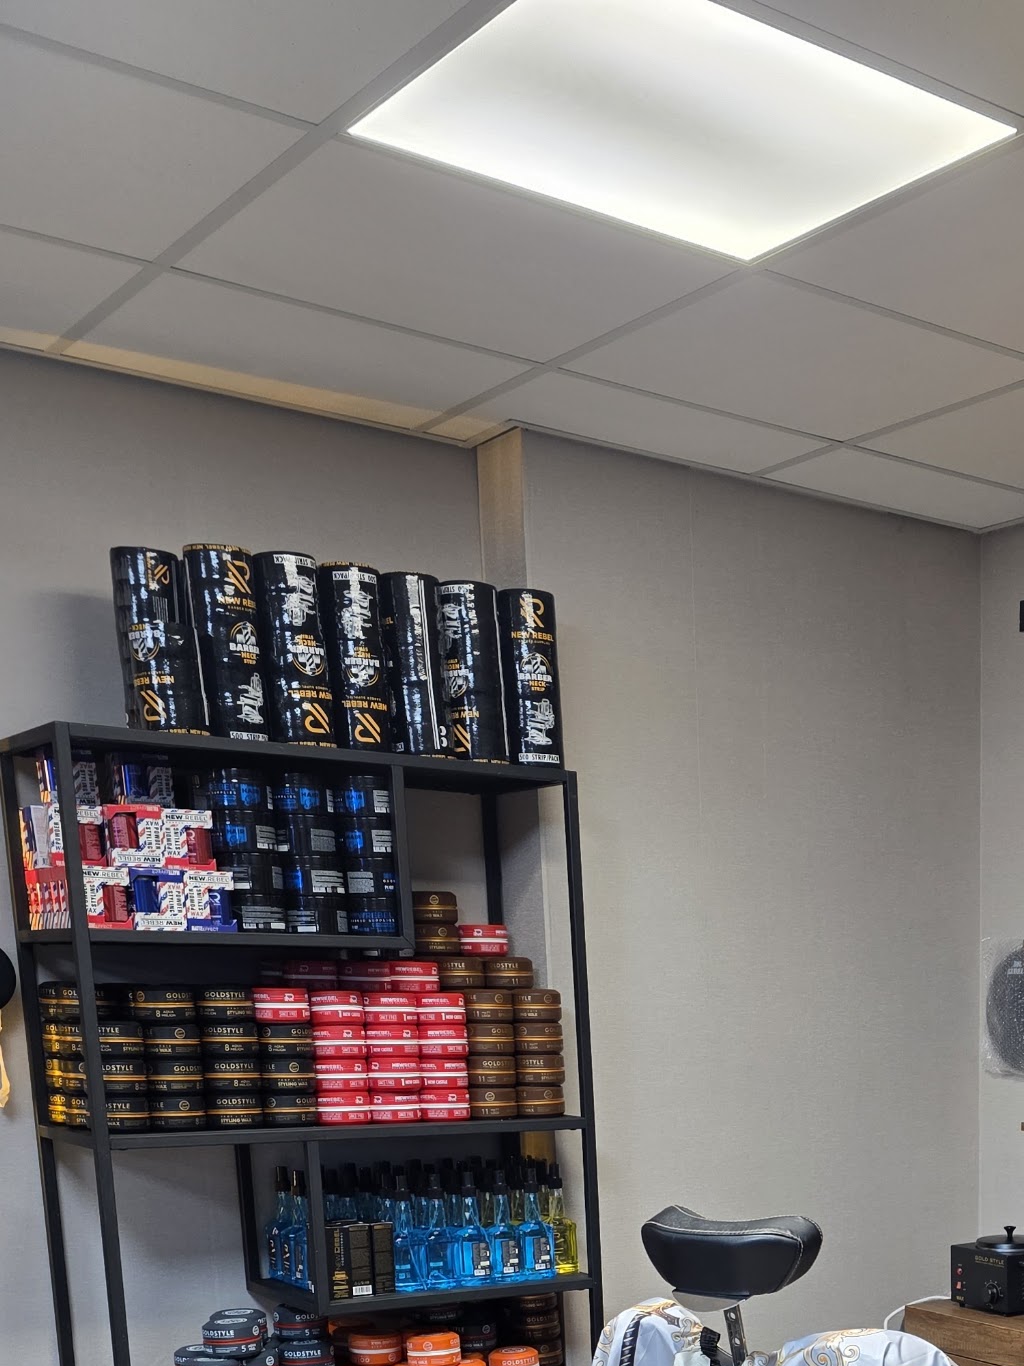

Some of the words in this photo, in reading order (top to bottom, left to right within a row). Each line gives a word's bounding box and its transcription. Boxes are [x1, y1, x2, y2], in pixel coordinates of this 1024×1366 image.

[511, 631, 532, 639] NEW
[533, 632, 554, 642] REBEL
[519, 673, 552, 682] BARBER
[342, 700, 366, 708] REBEL
[368, 702, 387, 710] NEW
[502, 1357, 535, 1365] GOLDSTYLE
